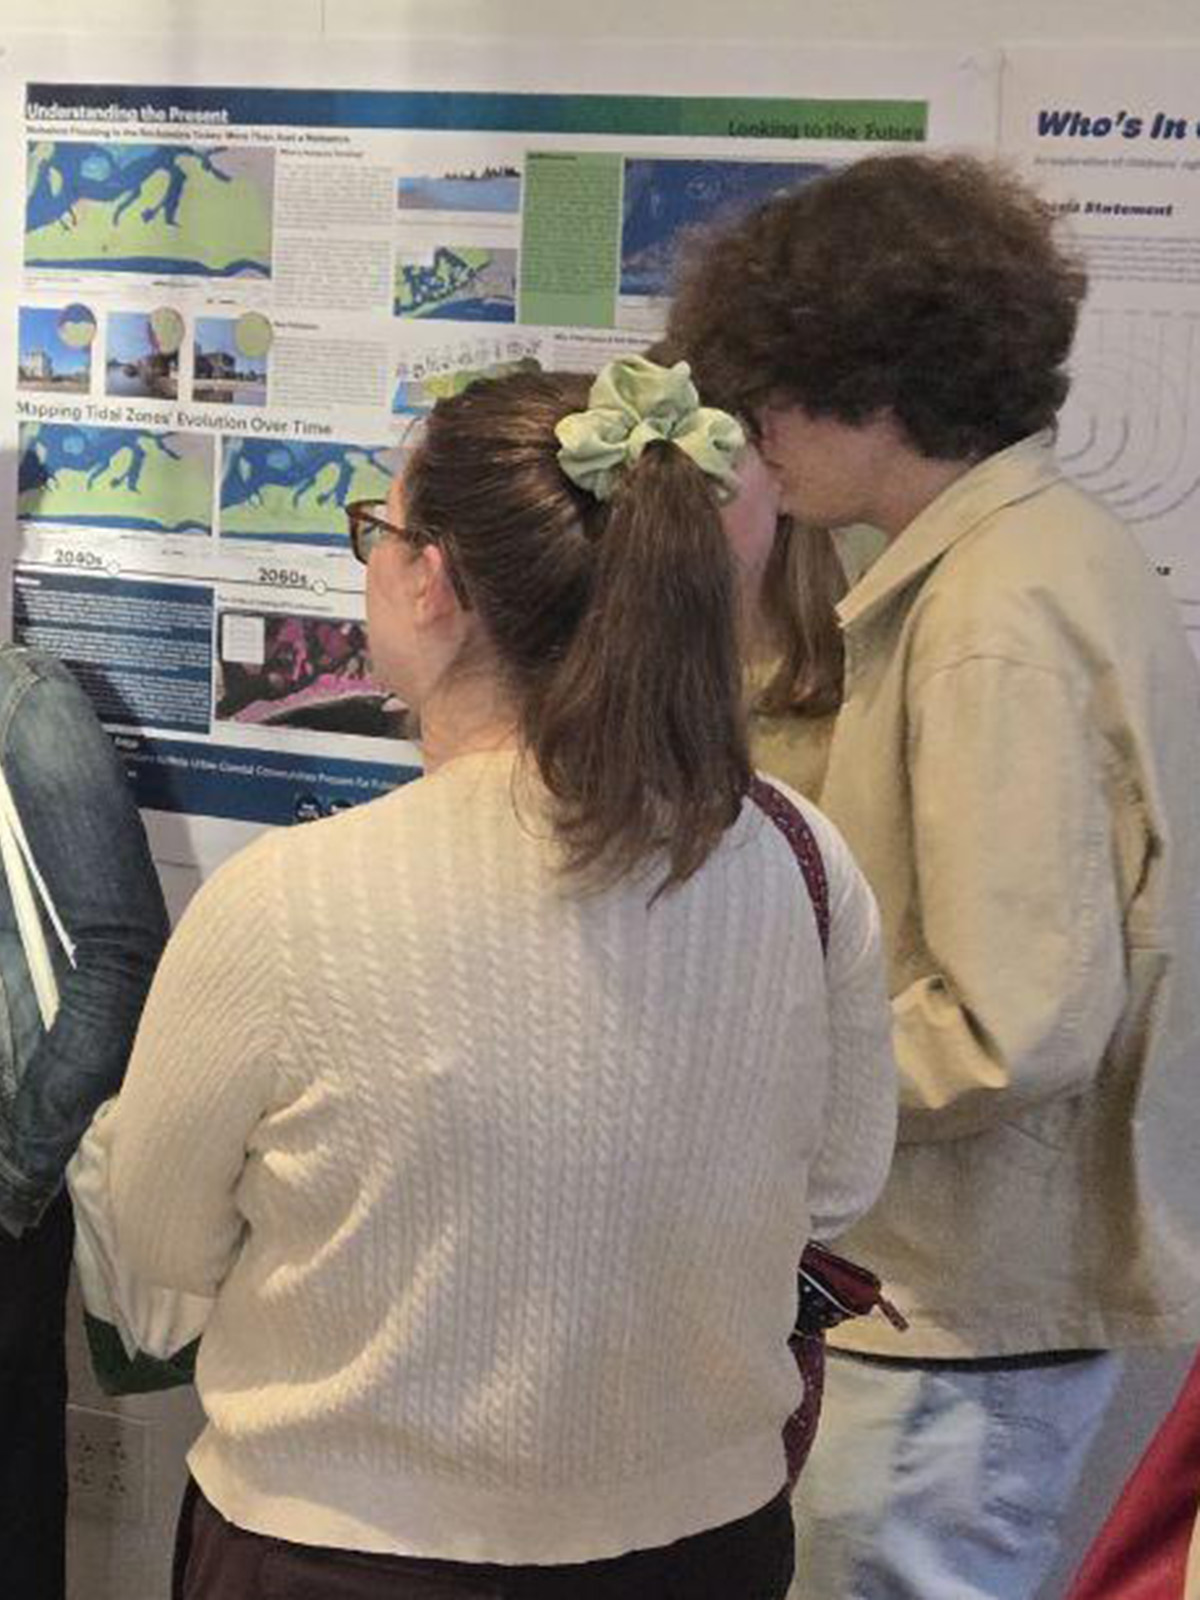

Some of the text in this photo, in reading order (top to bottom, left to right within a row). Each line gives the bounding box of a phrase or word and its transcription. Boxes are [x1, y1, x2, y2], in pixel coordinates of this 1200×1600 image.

[27, 103, 229, 124] Understanding the Present
[728, 120, 926, 141] Looking to the Future
[1038, 111, 1187, 139] Who's In
[1084, 201, 1173, 216] Statement
[16, 401, 82, 421] Mapping
[85, 404, 121, 421] Tidal
[177, 411, 247, 430] Evolution
[251, 417, 288, 433] Over
[293, 419, 332, 434] Time
